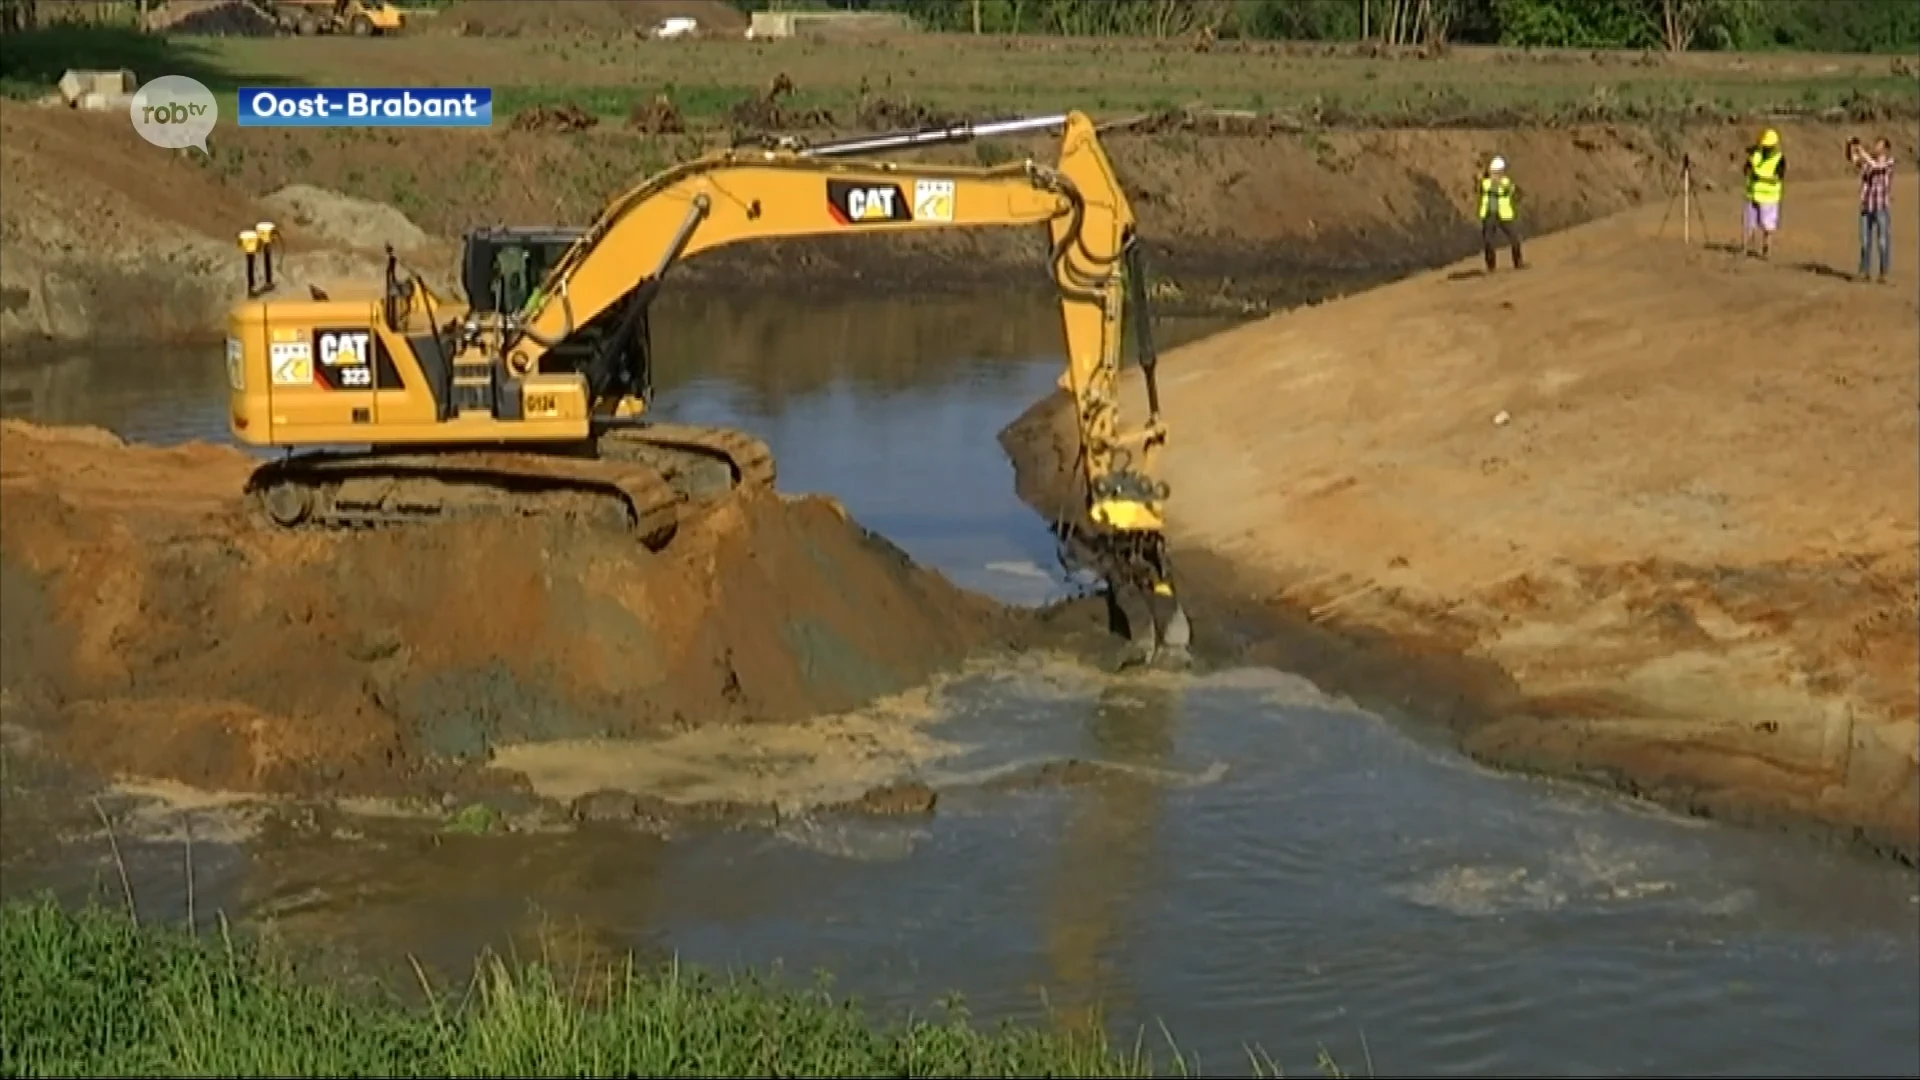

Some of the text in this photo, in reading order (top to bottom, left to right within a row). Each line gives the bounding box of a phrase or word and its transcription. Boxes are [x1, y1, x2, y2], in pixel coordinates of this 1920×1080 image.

[847, 187, 896, 220] CAT
[319, 333, 369, 366] CAT
[340, 366, 371, 386] 323
